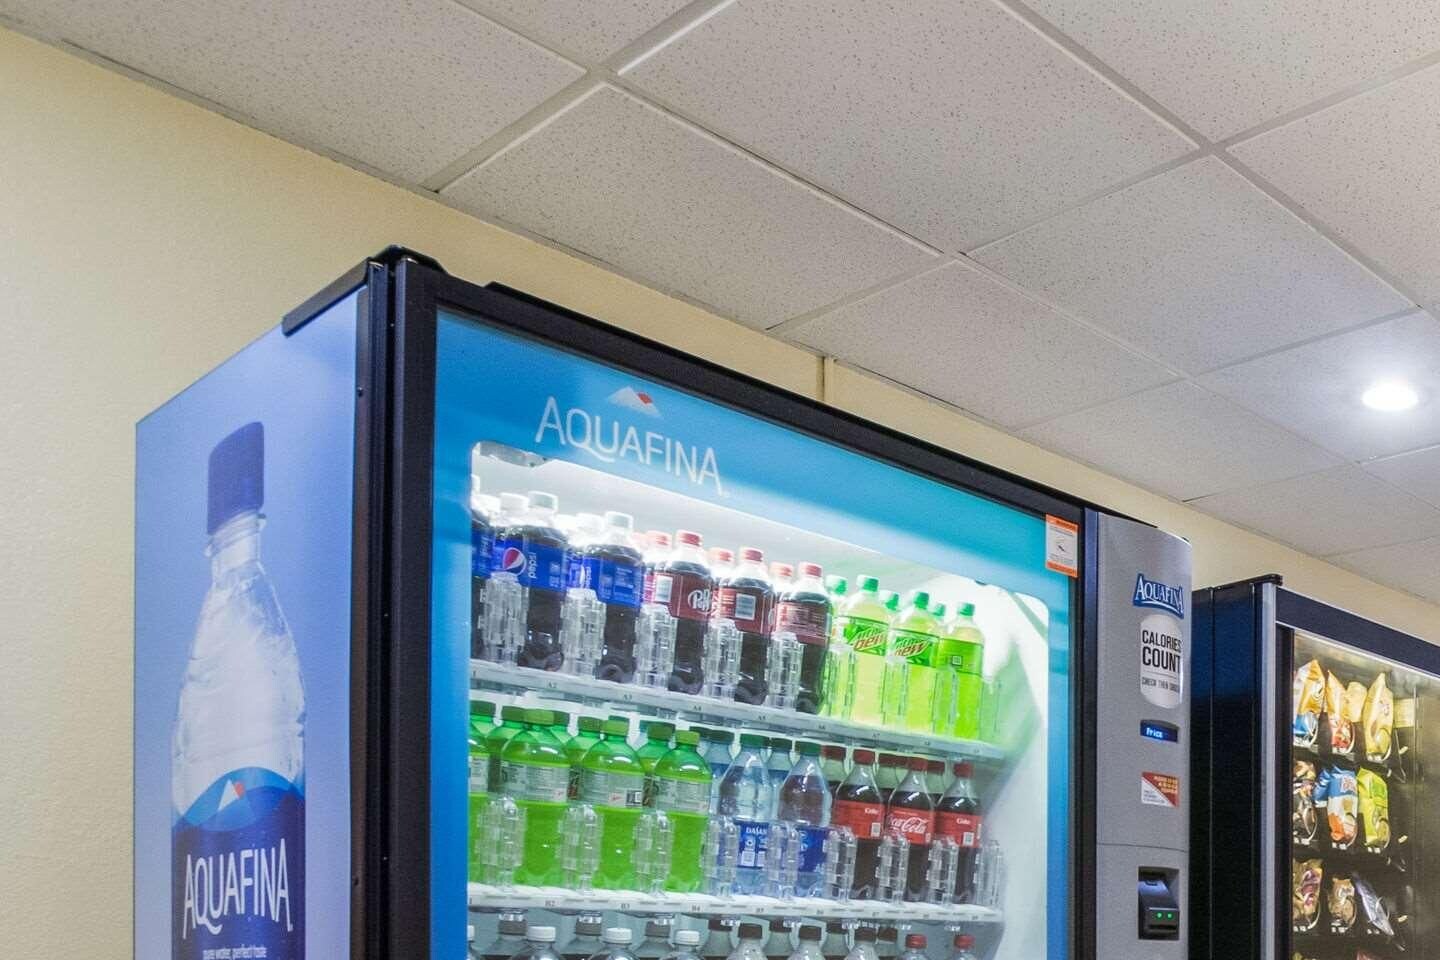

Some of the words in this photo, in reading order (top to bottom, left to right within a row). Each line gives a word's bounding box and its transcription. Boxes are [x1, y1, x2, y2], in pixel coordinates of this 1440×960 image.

[535, 396, 723, 497] AQUAFINA
[1135, 575, 1184, 613] AQUAFINA
[1142, 629, 1182, 653] CALORIES
[1142, 646, 1181, 673] COUNT
[182, 838, 293, 940] AQUAFINA
